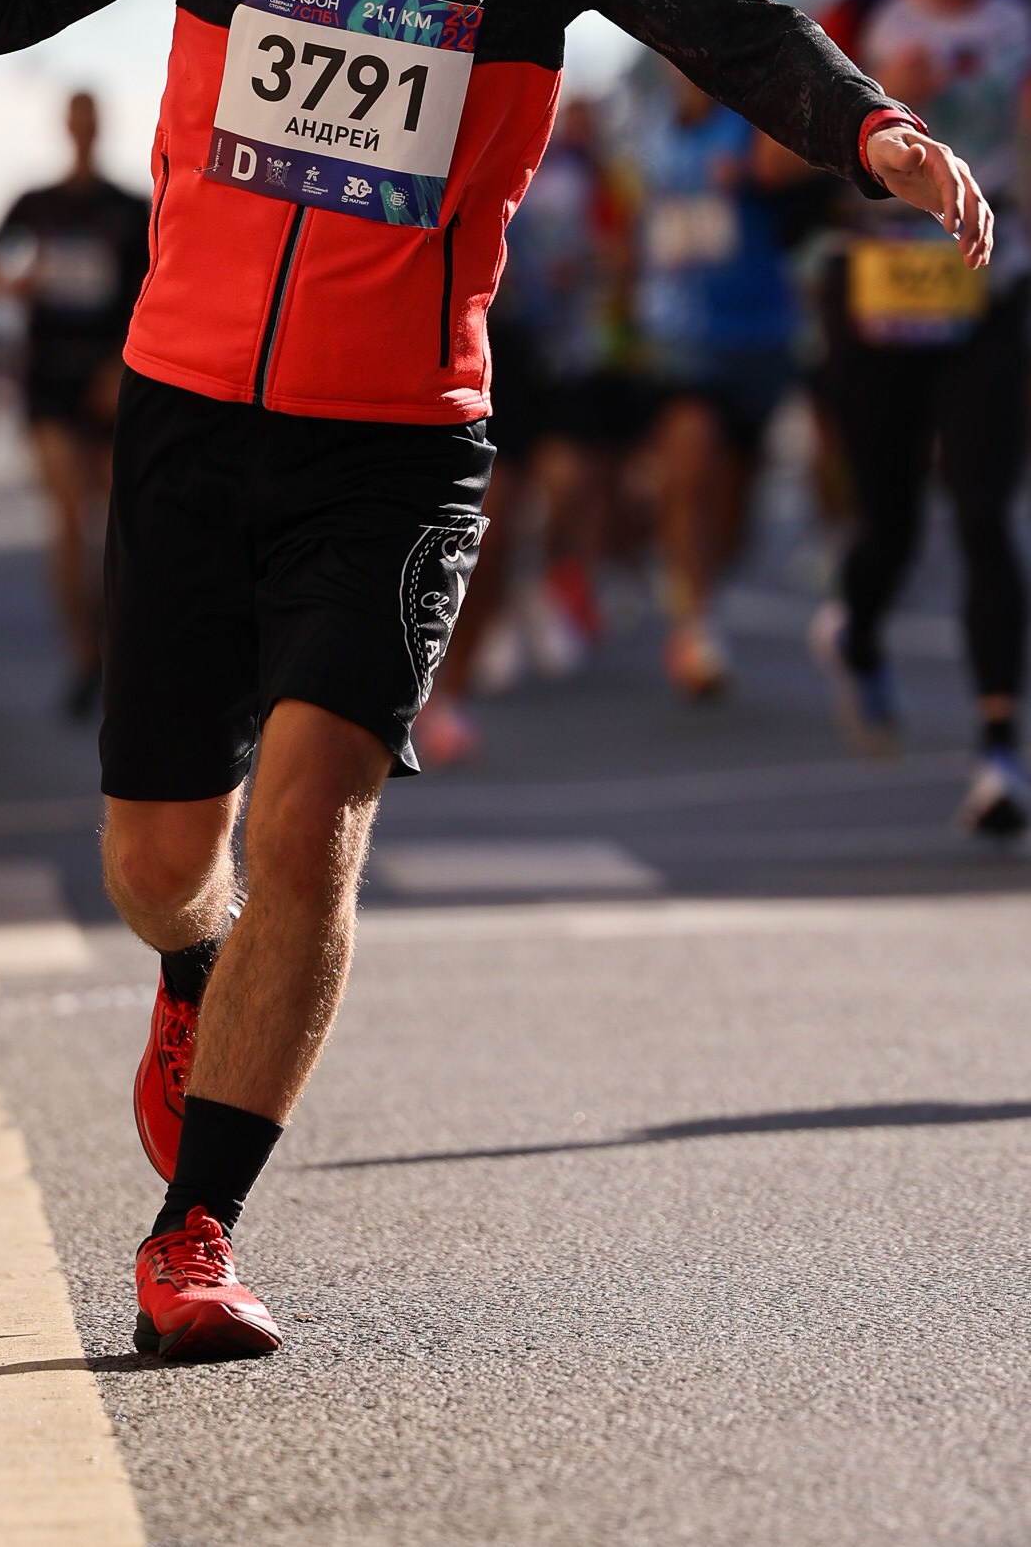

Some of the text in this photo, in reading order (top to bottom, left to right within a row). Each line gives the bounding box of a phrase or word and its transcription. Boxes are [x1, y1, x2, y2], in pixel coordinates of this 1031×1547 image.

[362, 2, 396, 24] 21,1
[445, 3, 484, 29] 20
[440, 27, 476, 53] 24
[251, 34, 429, 132] 3791
[284, 116, 381, 152] АНДРЕЙ
[231, 142, 258, 181] D
